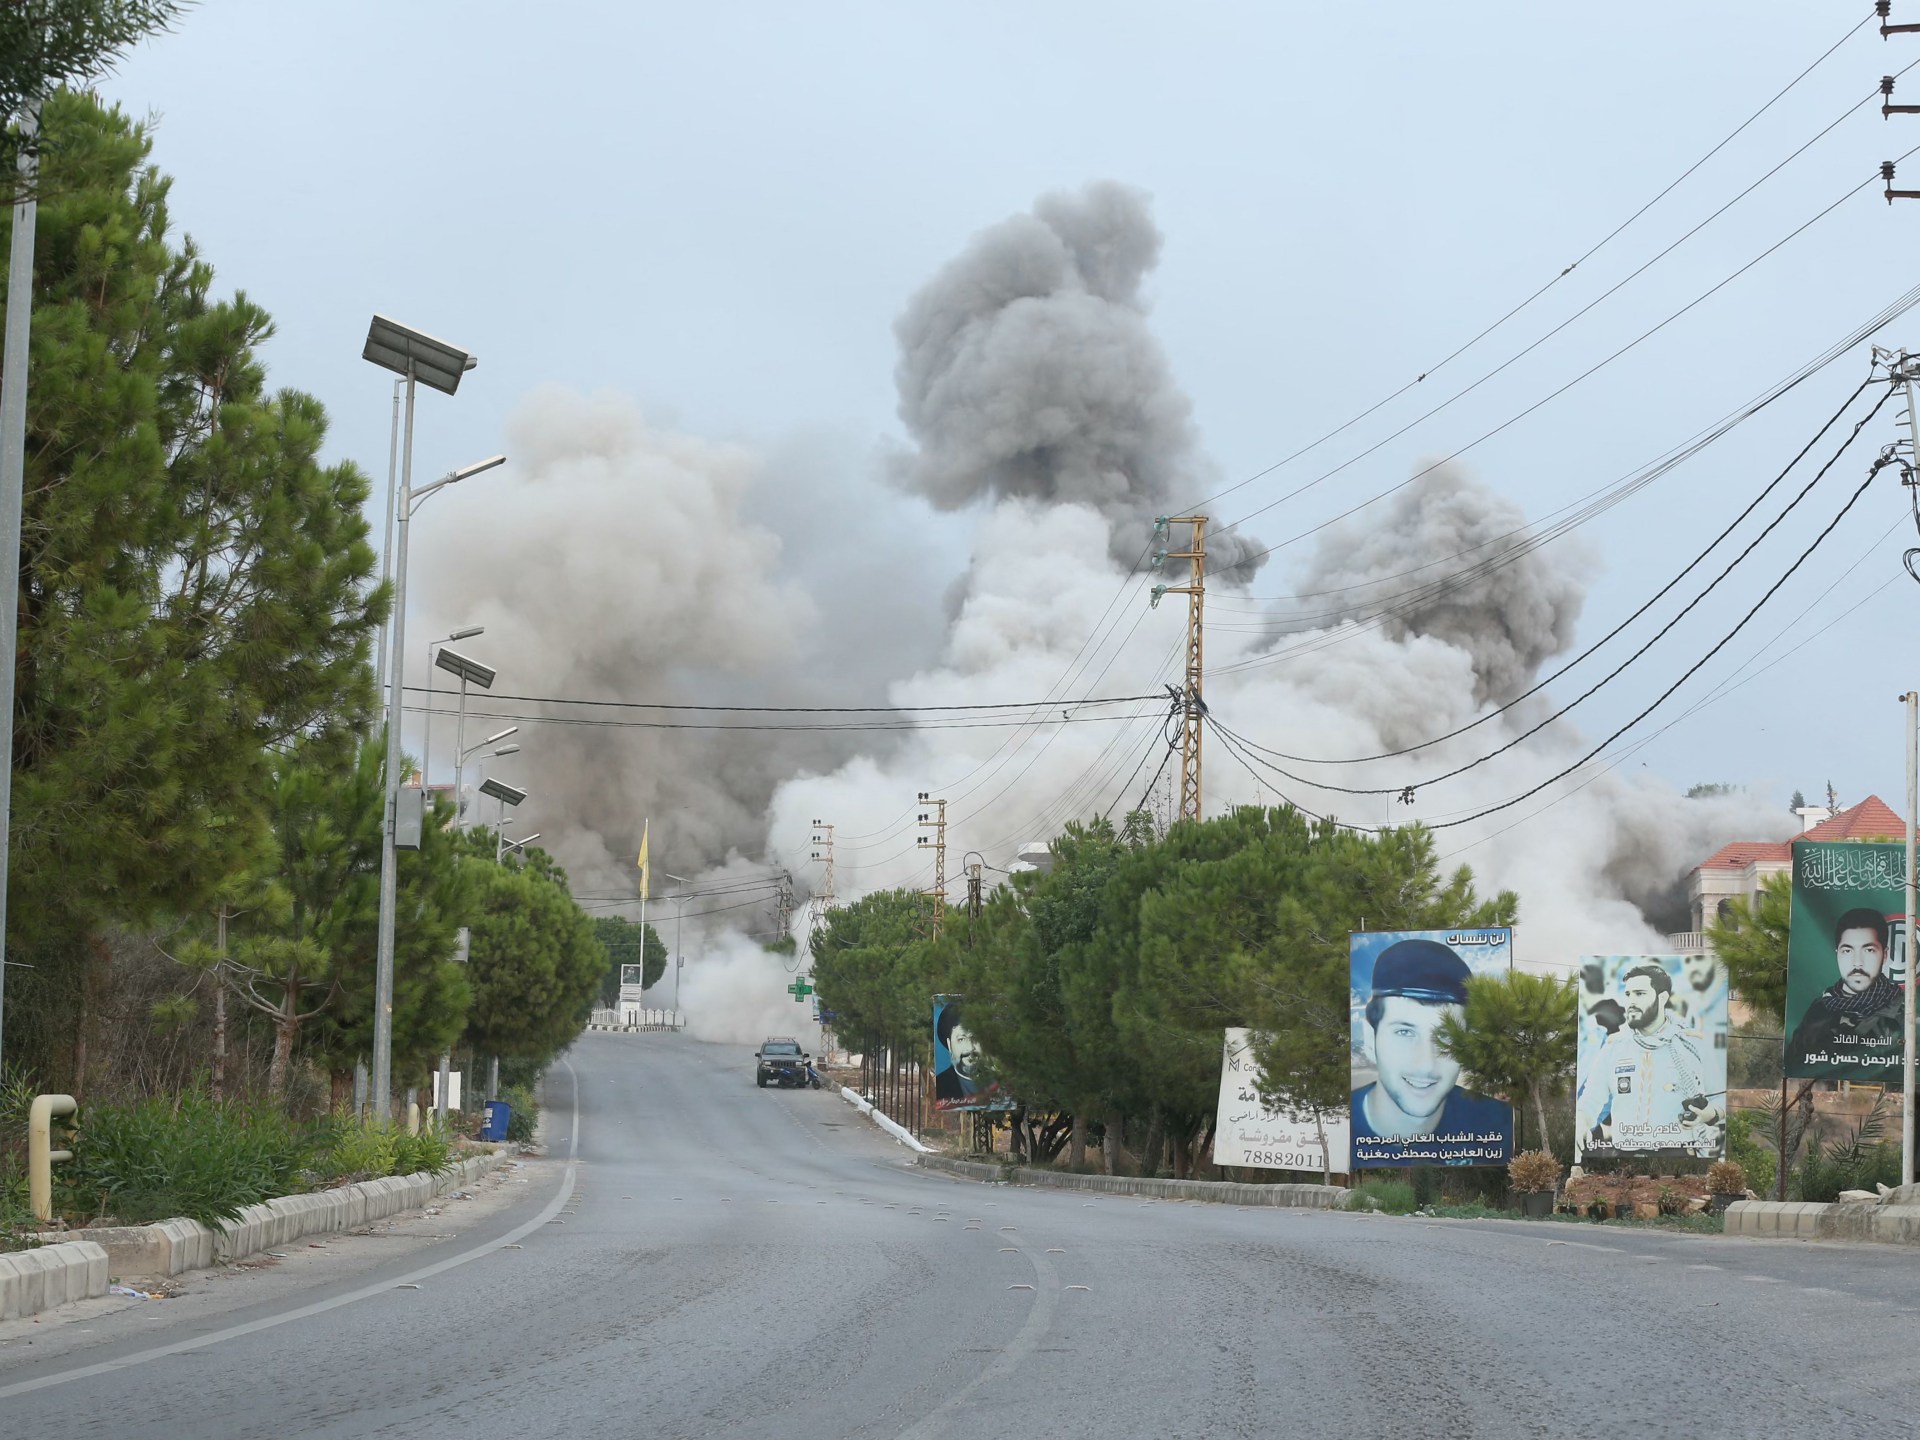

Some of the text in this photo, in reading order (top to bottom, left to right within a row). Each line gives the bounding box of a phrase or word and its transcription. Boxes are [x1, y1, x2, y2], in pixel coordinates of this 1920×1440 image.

[1447, 933, 1505, 945] لن ننساك
[1833, 1034, 1892, 1048] الشهيد القائد
[1804, 1050, 1828, 1064] شور
[1831, 1052, 1859, 1065] حسن
[1861, 1054, 1899, 1067] الرحمن
[1620, 1121, 1681, 1137] خادم طيردبا
[1239, 1128, 1292, 1147] مفروشة
[1356, 1131, 1503, 1147] فقيد الشباب الغالي المرحوم
[1586, 1138, 1716, 1151] الشهيد مهدي مصطفى حجازي
[1243, 1150, 1324, 1167] 78882011
[1356, 1148, 1503, 1161] زين العابدين مصطفى مغنية
